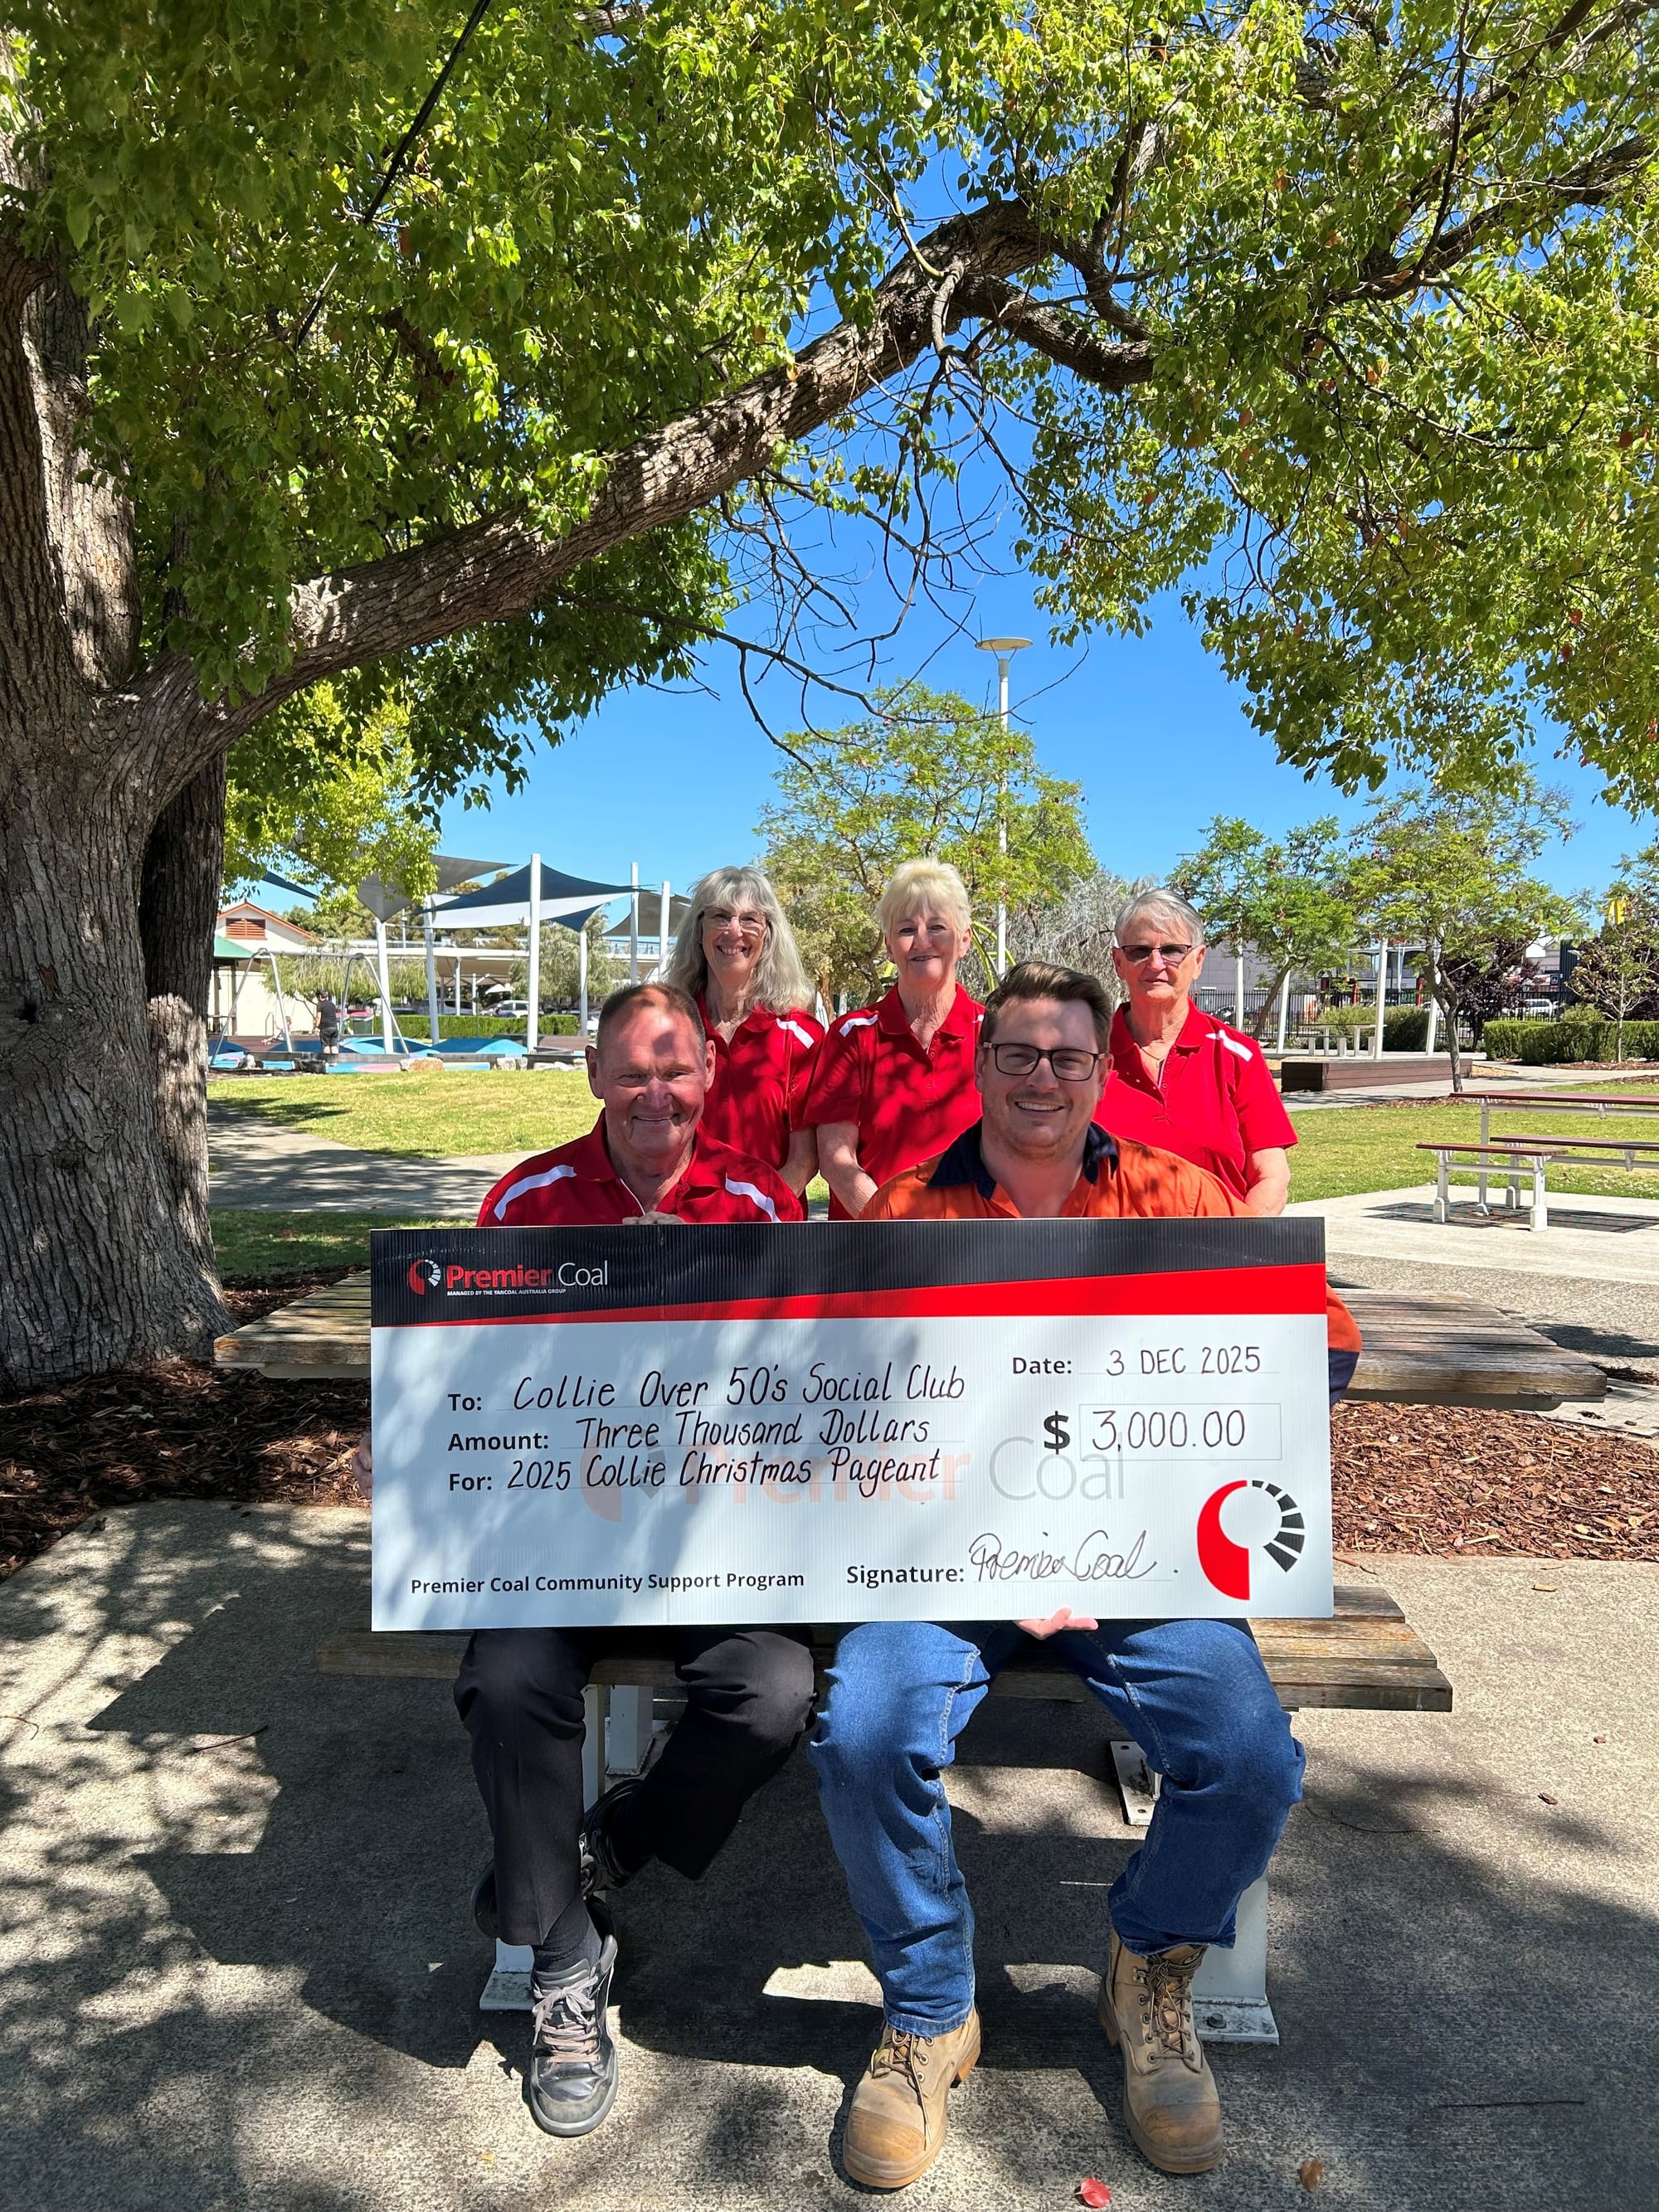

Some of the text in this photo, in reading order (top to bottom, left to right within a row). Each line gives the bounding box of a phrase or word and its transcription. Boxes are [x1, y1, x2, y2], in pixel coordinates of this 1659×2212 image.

[446, 1260, 608, 1289] Premier Coal
[1012, 1356, 1073, 1375] Date:
[1106, 1346, 1261, 1376] 3 DEC 2025
[513, 1362, 965, 1410] Collie Over 50's Social Club
[448, 1393, 482, 1411] To:
[448, 1432, 549, 1451] Amount:
[576, 1408, 930, 1448] Three Thousand Dollars
[1043, 1410, 1071, 1455] $
[1092, 1410, 1246, 1453] 3,000.00
[449, 1472, 492, 1491] For:
[507, 1446, 940, 1498] 2025 Collie Christmas Pageant
[685, 1432, 1125, 1504] Premier Coal
[411, 1570, 805, 1593] Premier Coal Community Support Program
[846, 1564, 965, 1586] Signature:
